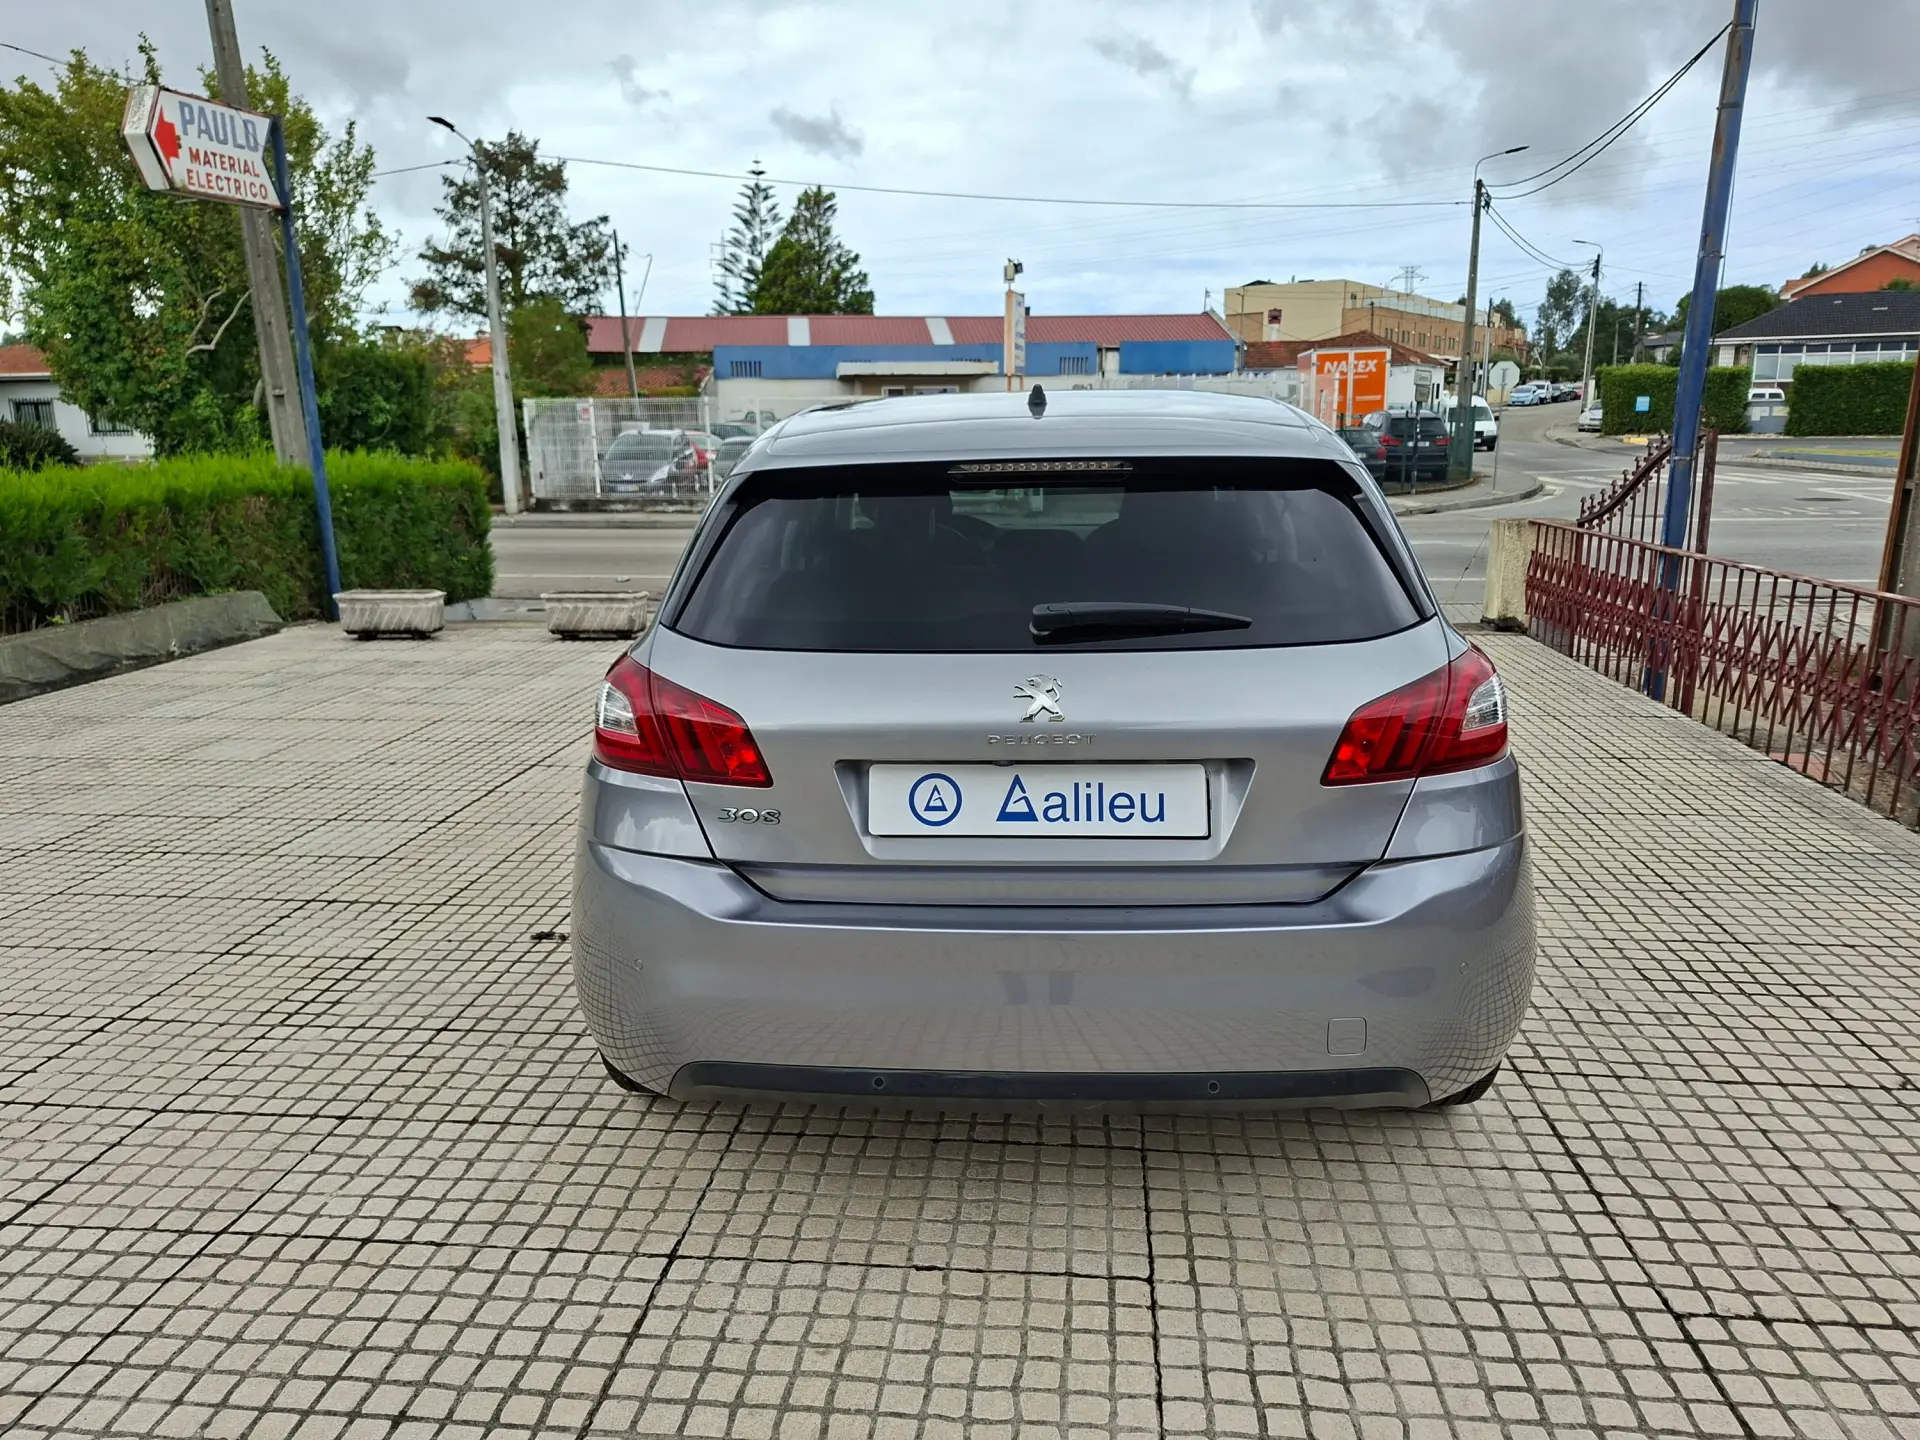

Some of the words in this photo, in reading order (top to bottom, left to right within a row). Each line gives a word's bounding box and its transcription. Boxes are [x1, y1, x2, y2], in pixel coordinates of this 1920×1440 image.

[178, 101, 259, 152] PAULO
[188, 147, 260, 178] MATERIAL
[186, 168, 268, 200] ELECTRICO
[988, 733, 1096, 745] PEUGEOT
[717, 807, 781, 825] 308
